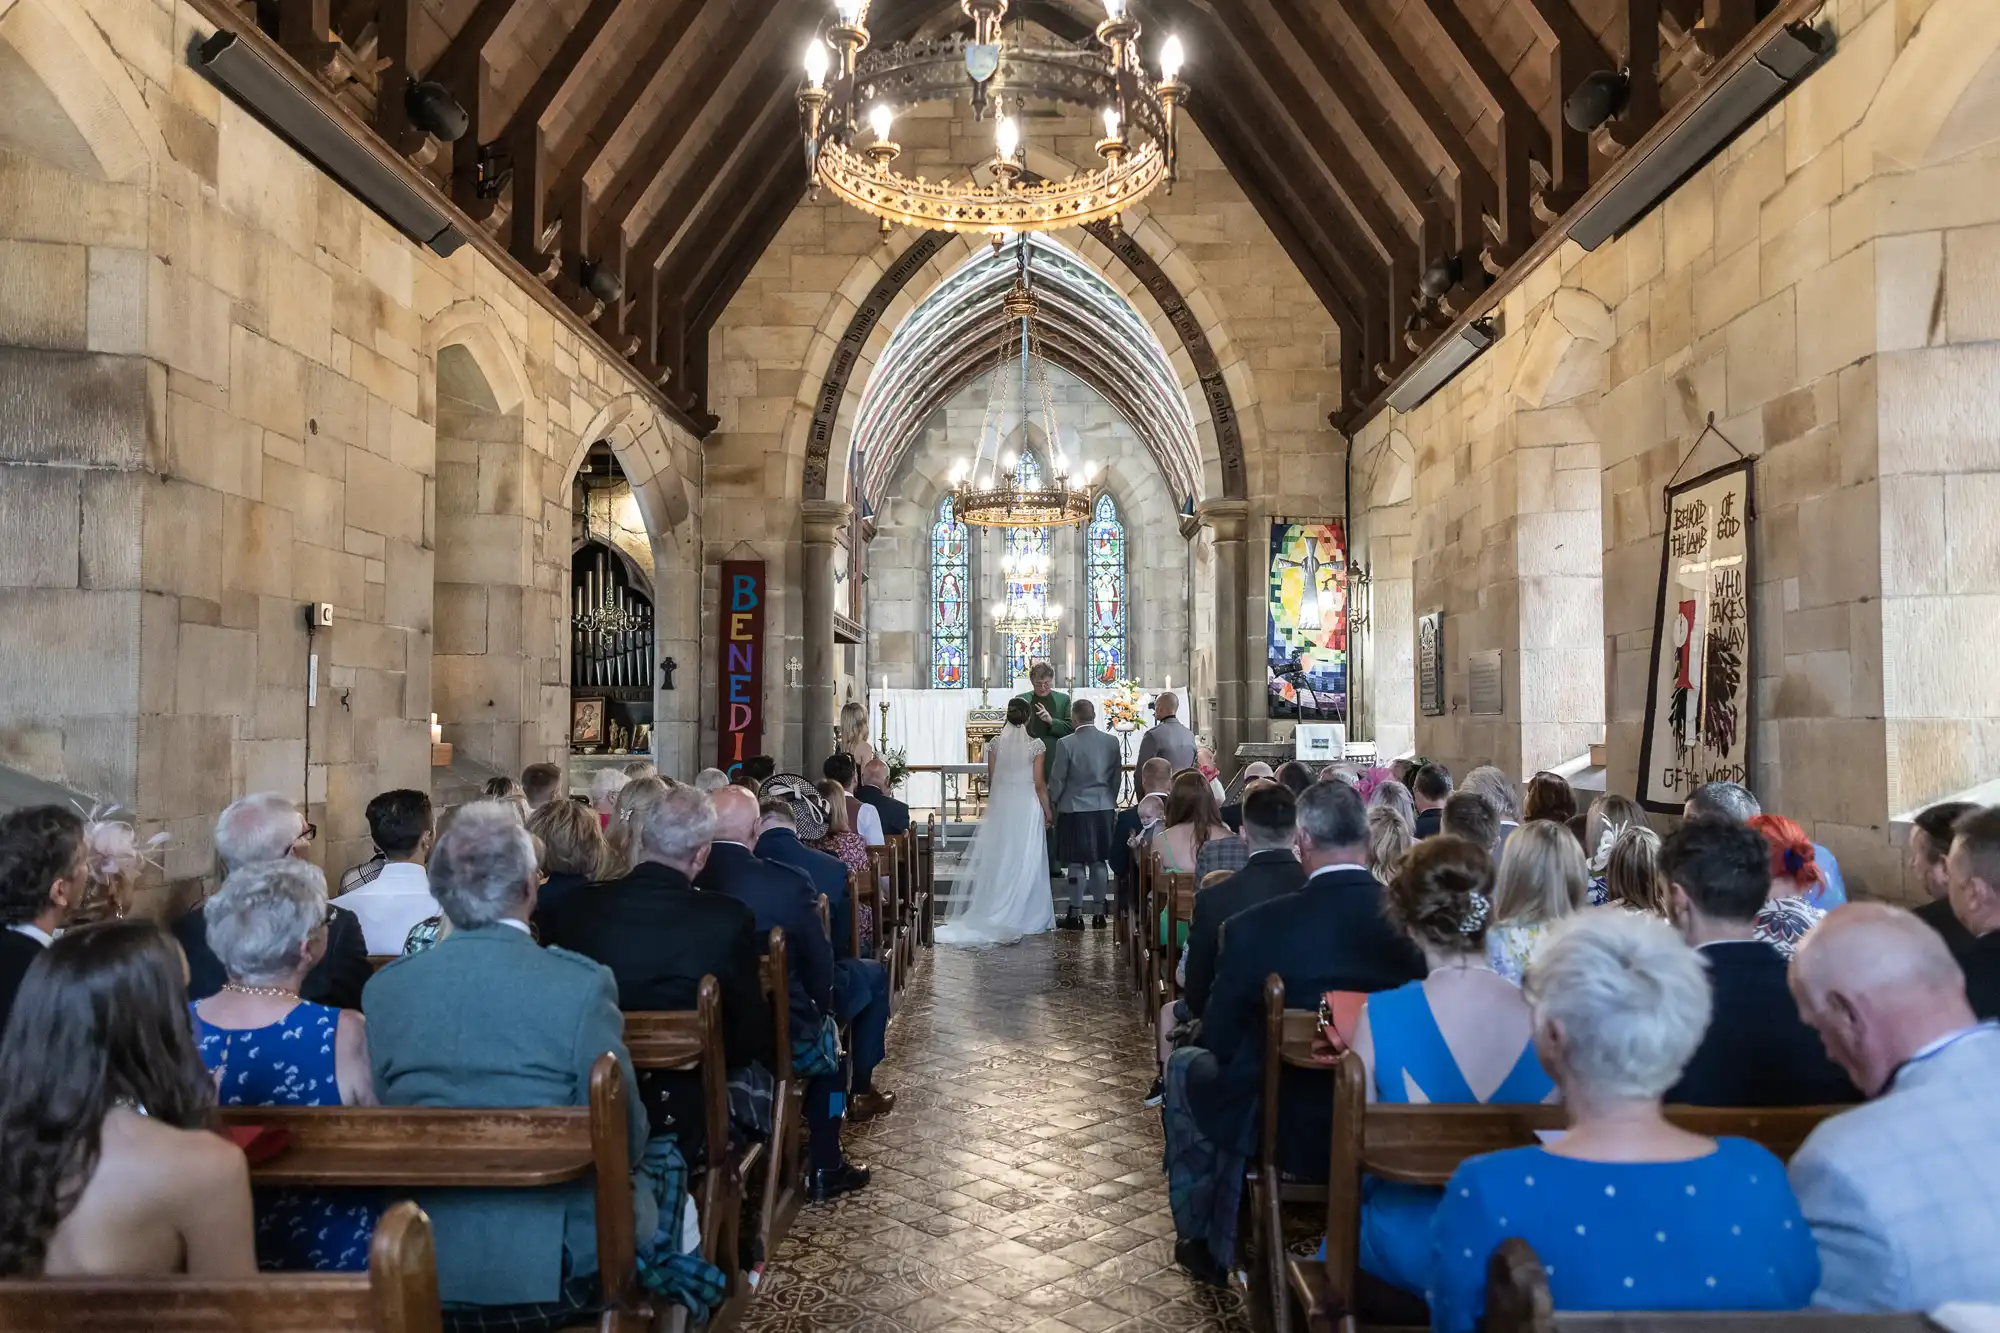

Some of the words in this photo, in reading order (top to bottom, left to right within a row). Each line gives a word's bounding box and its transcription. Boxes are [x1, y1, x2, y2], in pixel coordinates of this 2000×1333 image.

[1673, 499, 1706, 531] BEHOLD
[1721, 491, 1736, 518] OF
[1670, 533, 1686, 558] THE
[1686, 526, 1707, 554] LAMB
[1717, 516, 1740, 540] GOD
[1714, 569, 1742, 597] WHO
[1710, 597, 1745, 626] TAKES
[1713, 622, 1746, 653] AWAY
